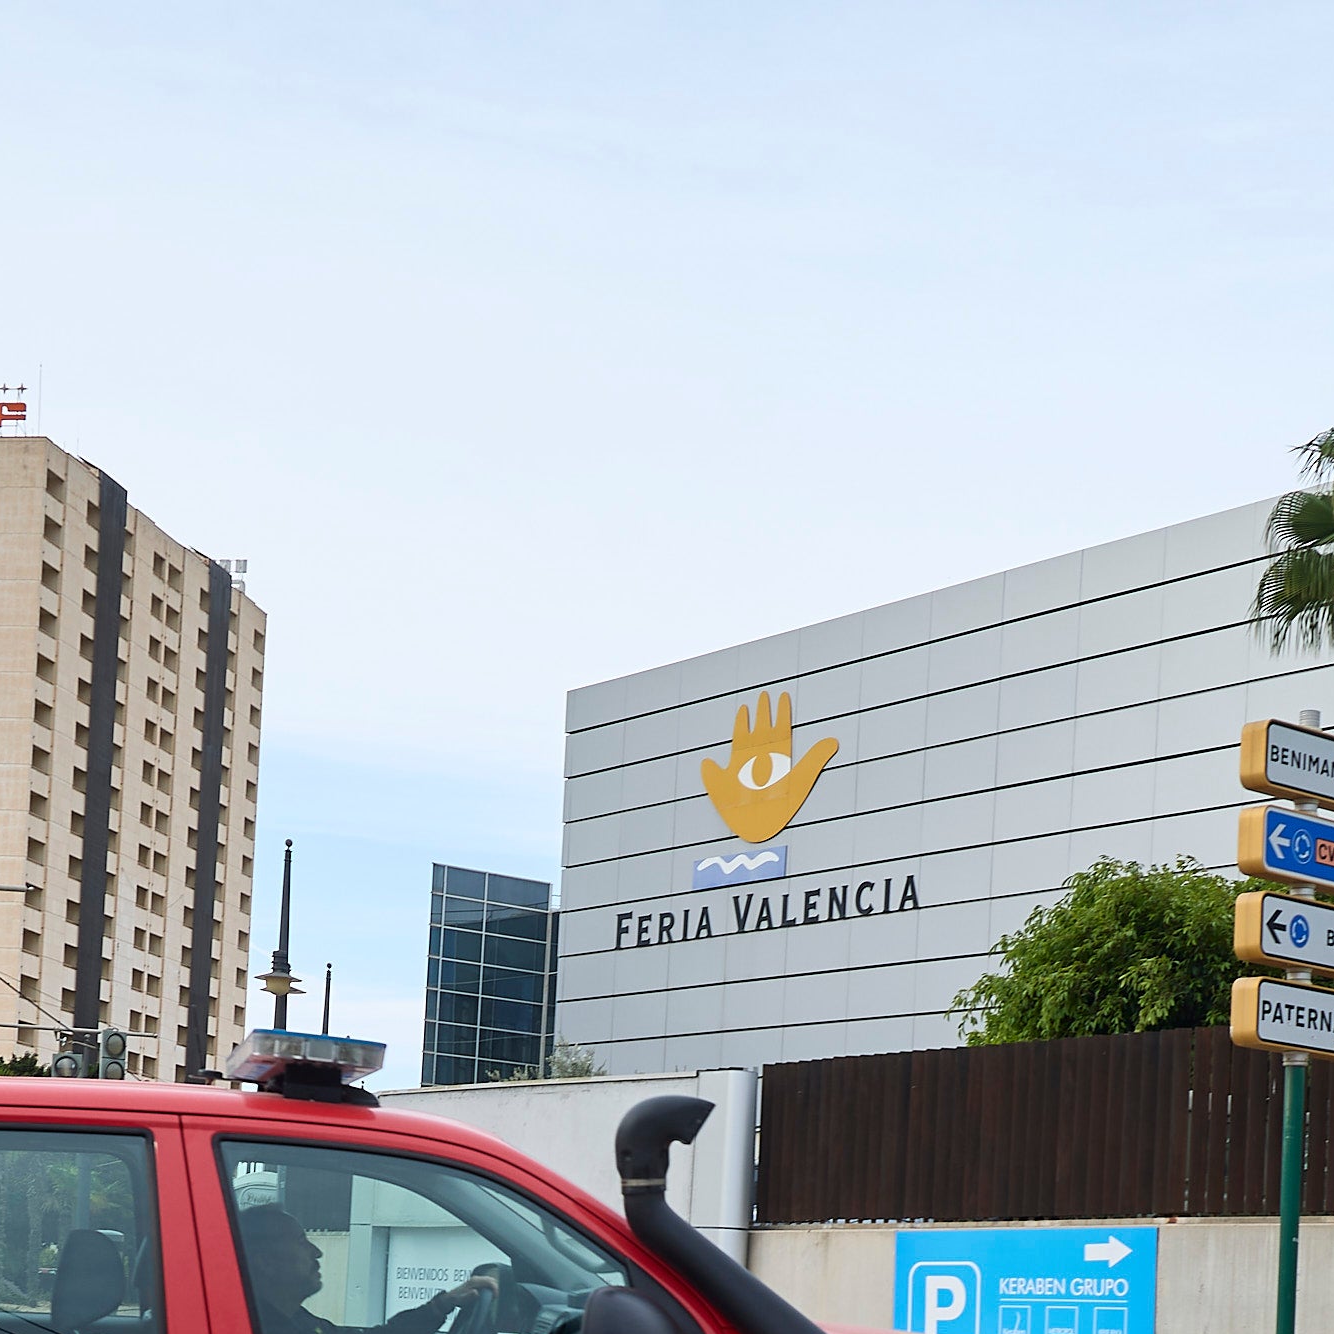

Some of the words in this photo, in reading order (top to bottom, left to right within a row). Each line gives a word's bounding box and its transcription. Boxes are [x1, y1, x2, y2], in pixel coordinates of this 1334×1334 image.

[615, 906, 713, 950] FERIA
[732, 874, 921, 933] VALENCIA
[999, 1278, 1066, 1296] KERABEN
[1069, 1278, 1129, 1297] GRUPO
